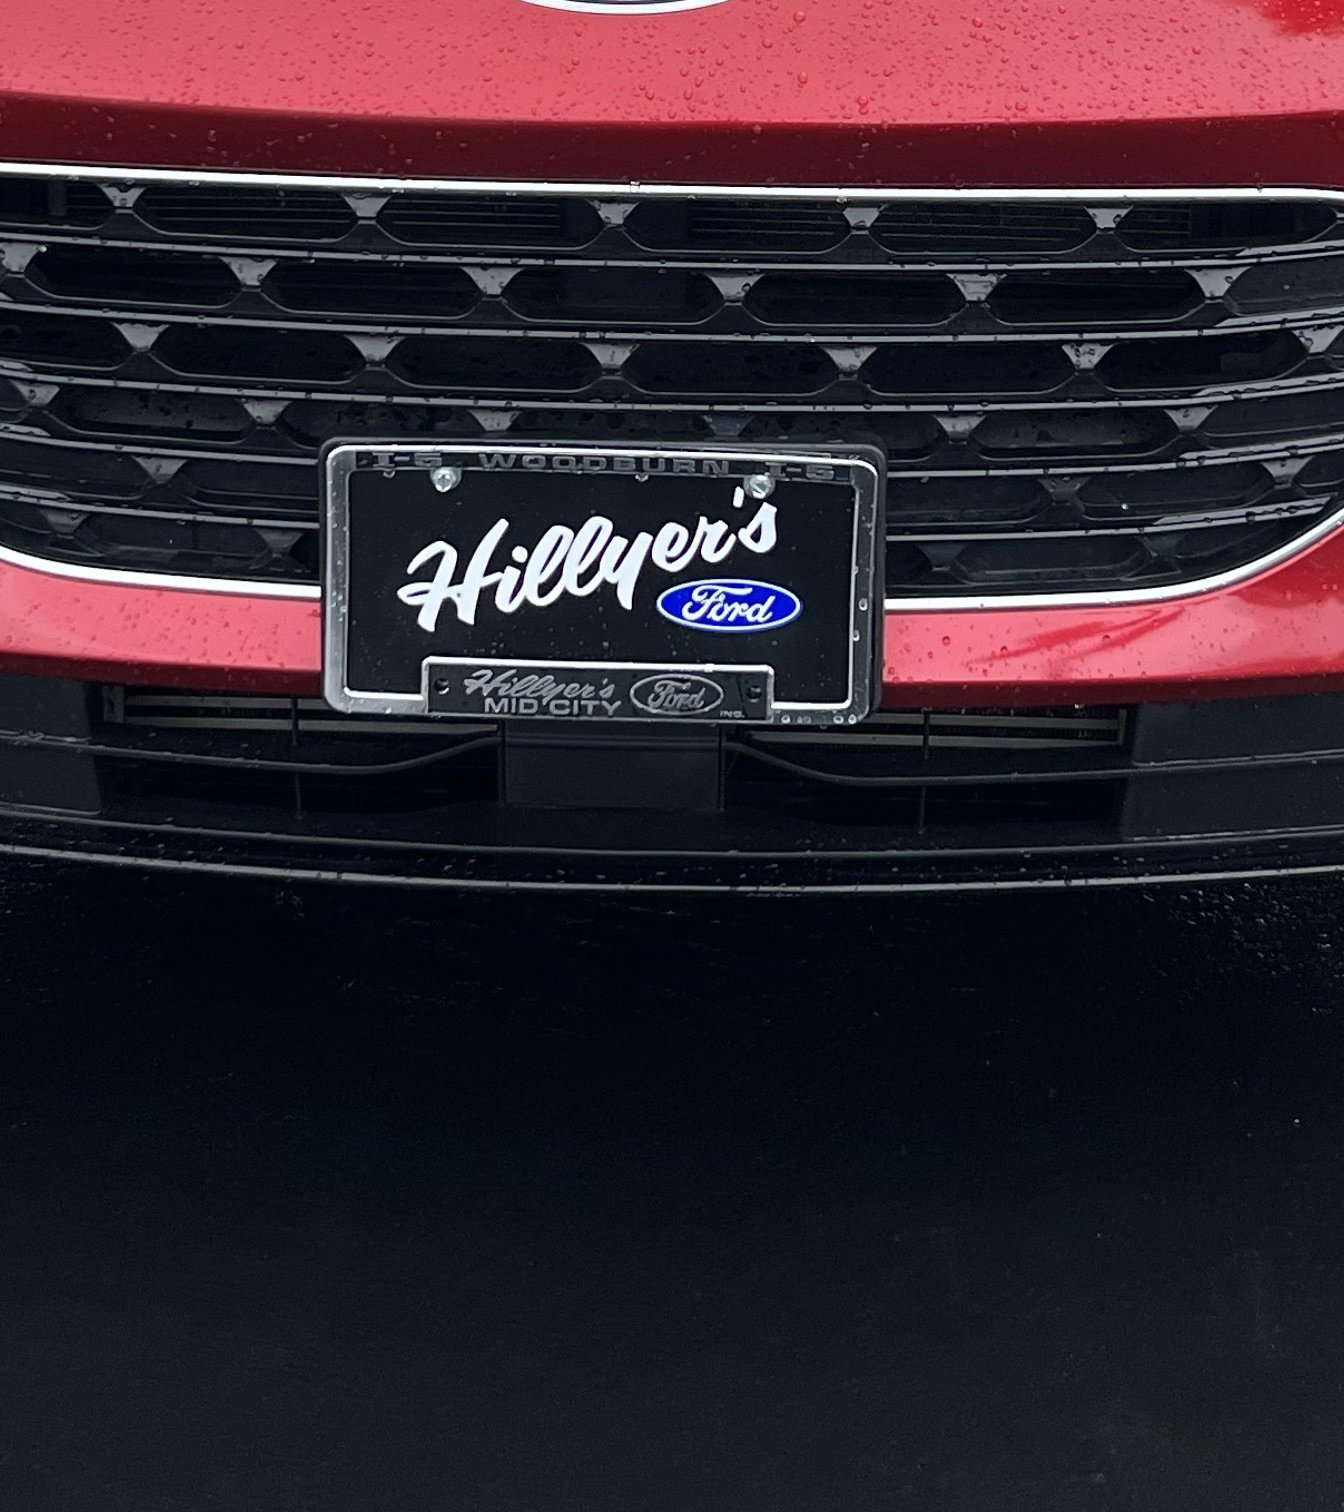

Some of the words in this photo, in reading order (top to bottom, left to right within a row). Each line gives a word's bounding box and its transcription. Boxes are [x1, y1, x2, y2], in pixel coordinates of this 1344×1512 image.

[372, 452, 442, 467] I-5
[478, 453, 729, 475] WOODBURN
[765, 461, 834, 480] I-5
[397, 487, 777, 632] Hillyer's
[682, 585, 774, 623] Ford
[464, 668, 615, 705] Hillyer's
[647, 680, 706, 709] Ford
[484, 697, 539, 714] MID
[549, 699, 622, 716] CITY
